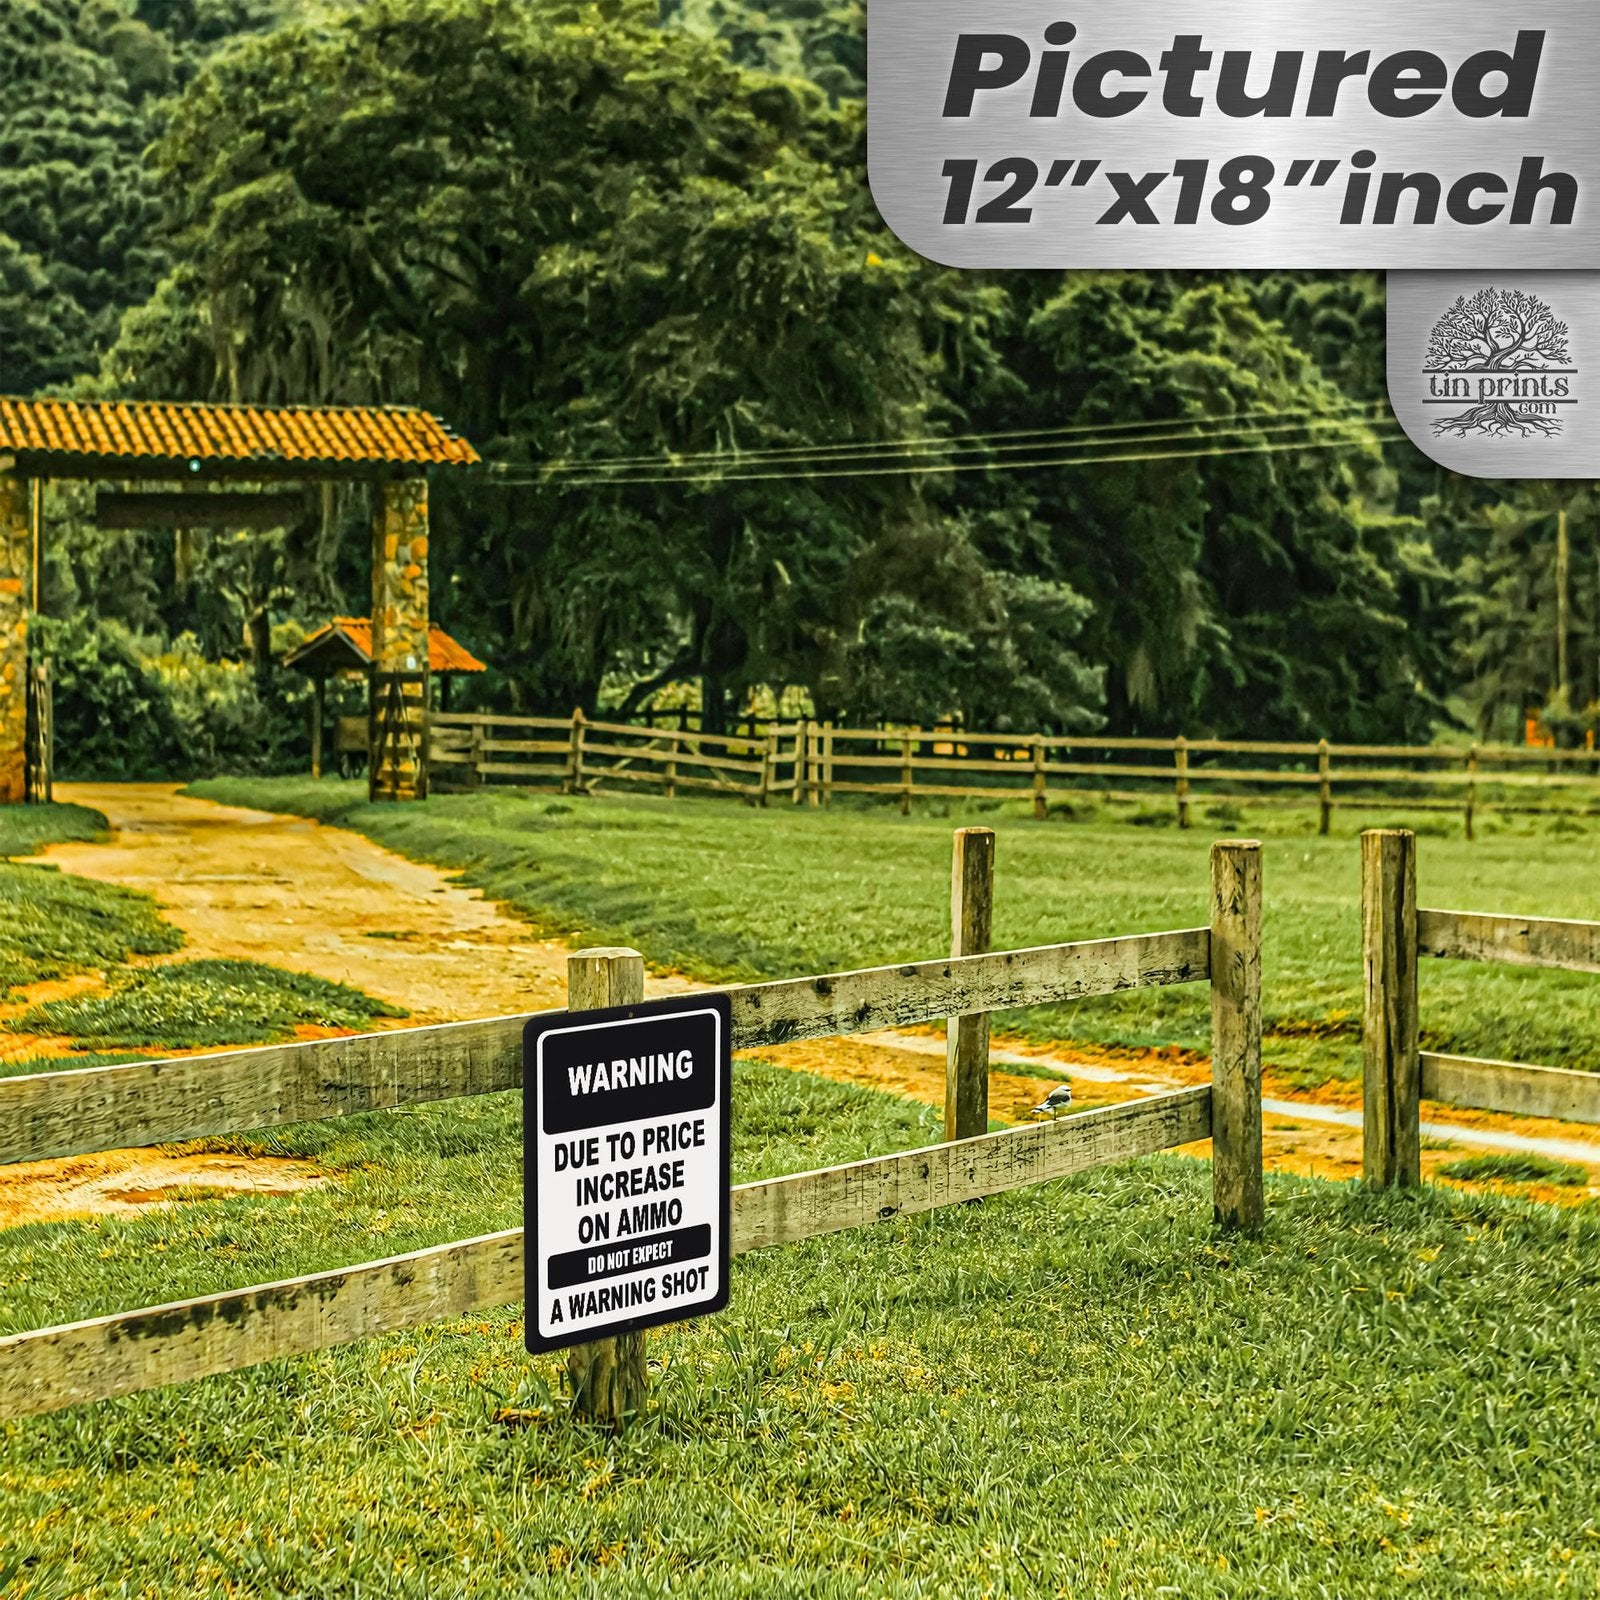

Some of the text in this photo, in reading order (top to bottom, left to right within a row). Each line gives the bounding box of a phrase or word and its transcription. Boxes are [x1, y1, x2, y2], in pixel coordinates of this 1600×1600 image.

[568, 1049, 693, 1096] WARNING
[554, 1119, 705, 1172] DUE TO PRICE
[576, 1160, 685, 1207] INCREASE
[578, 1198, 682, 1244] ON AMMO
[588, 1240, 673, 1275] DO NOT EXPECT
[551, 1265, 709, 1325] A WARNING SHOT
